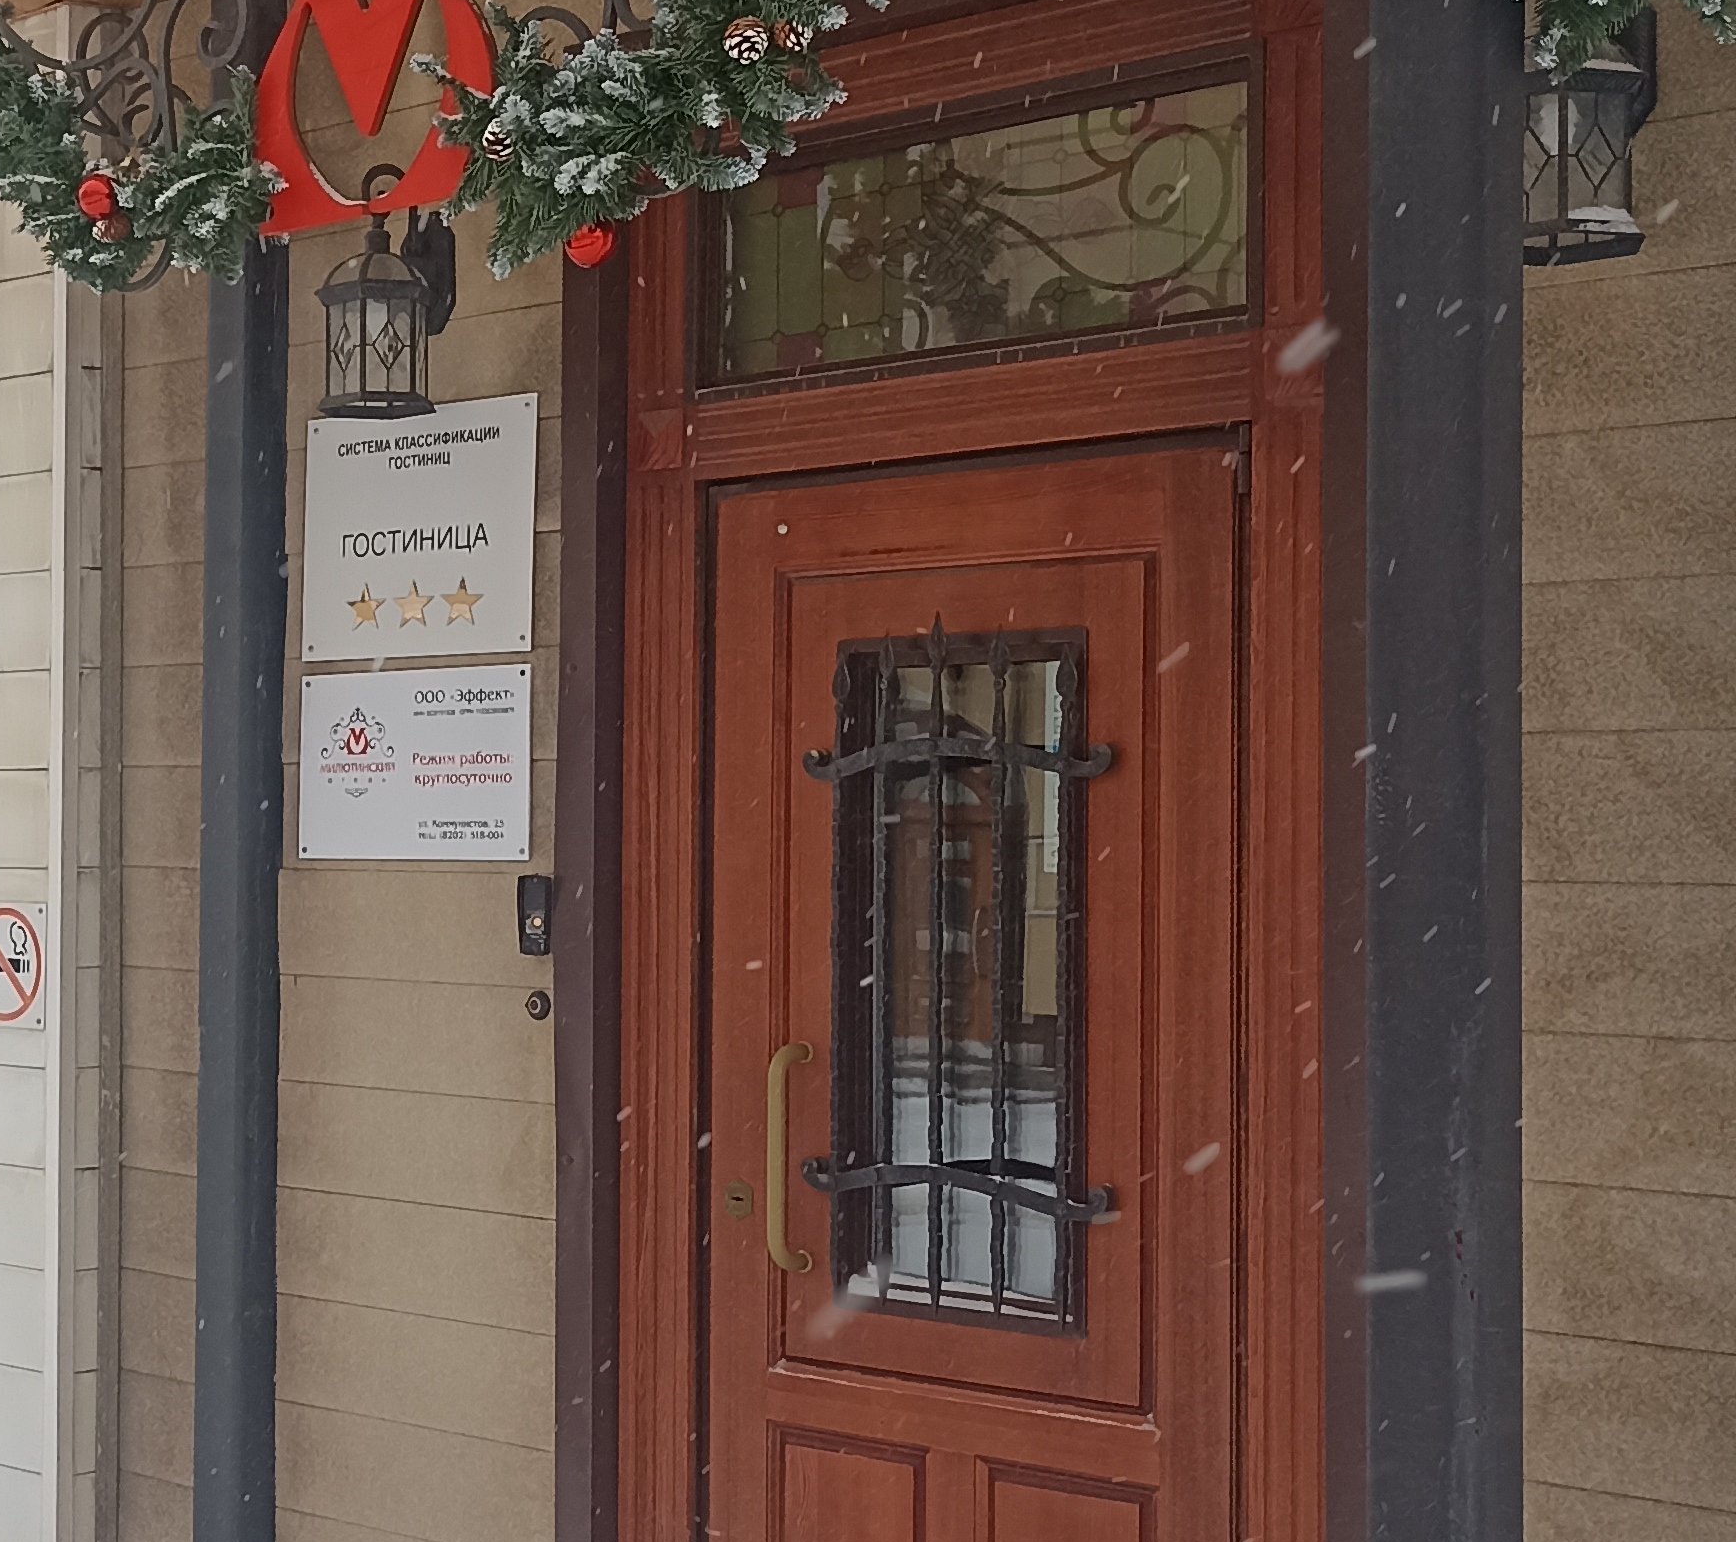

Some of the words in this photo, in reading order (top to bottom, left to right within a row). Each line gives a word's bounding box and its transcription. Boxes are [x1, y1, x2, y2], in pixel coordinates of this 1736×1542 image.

[338, 439, 391, 457] СИСТЕМА
[395, 426, 501, 451] КЛАССИФИКАЦИИ
[389, 451, 451, 470] ГОСТИНИЦ
[342, 522, 489, 558] ГОСТИНИЦА
[414, 689, 446, 704] ООО
[412, 752, 456, 766] Режим
[414, 772, 513, 787] круглосуточно
